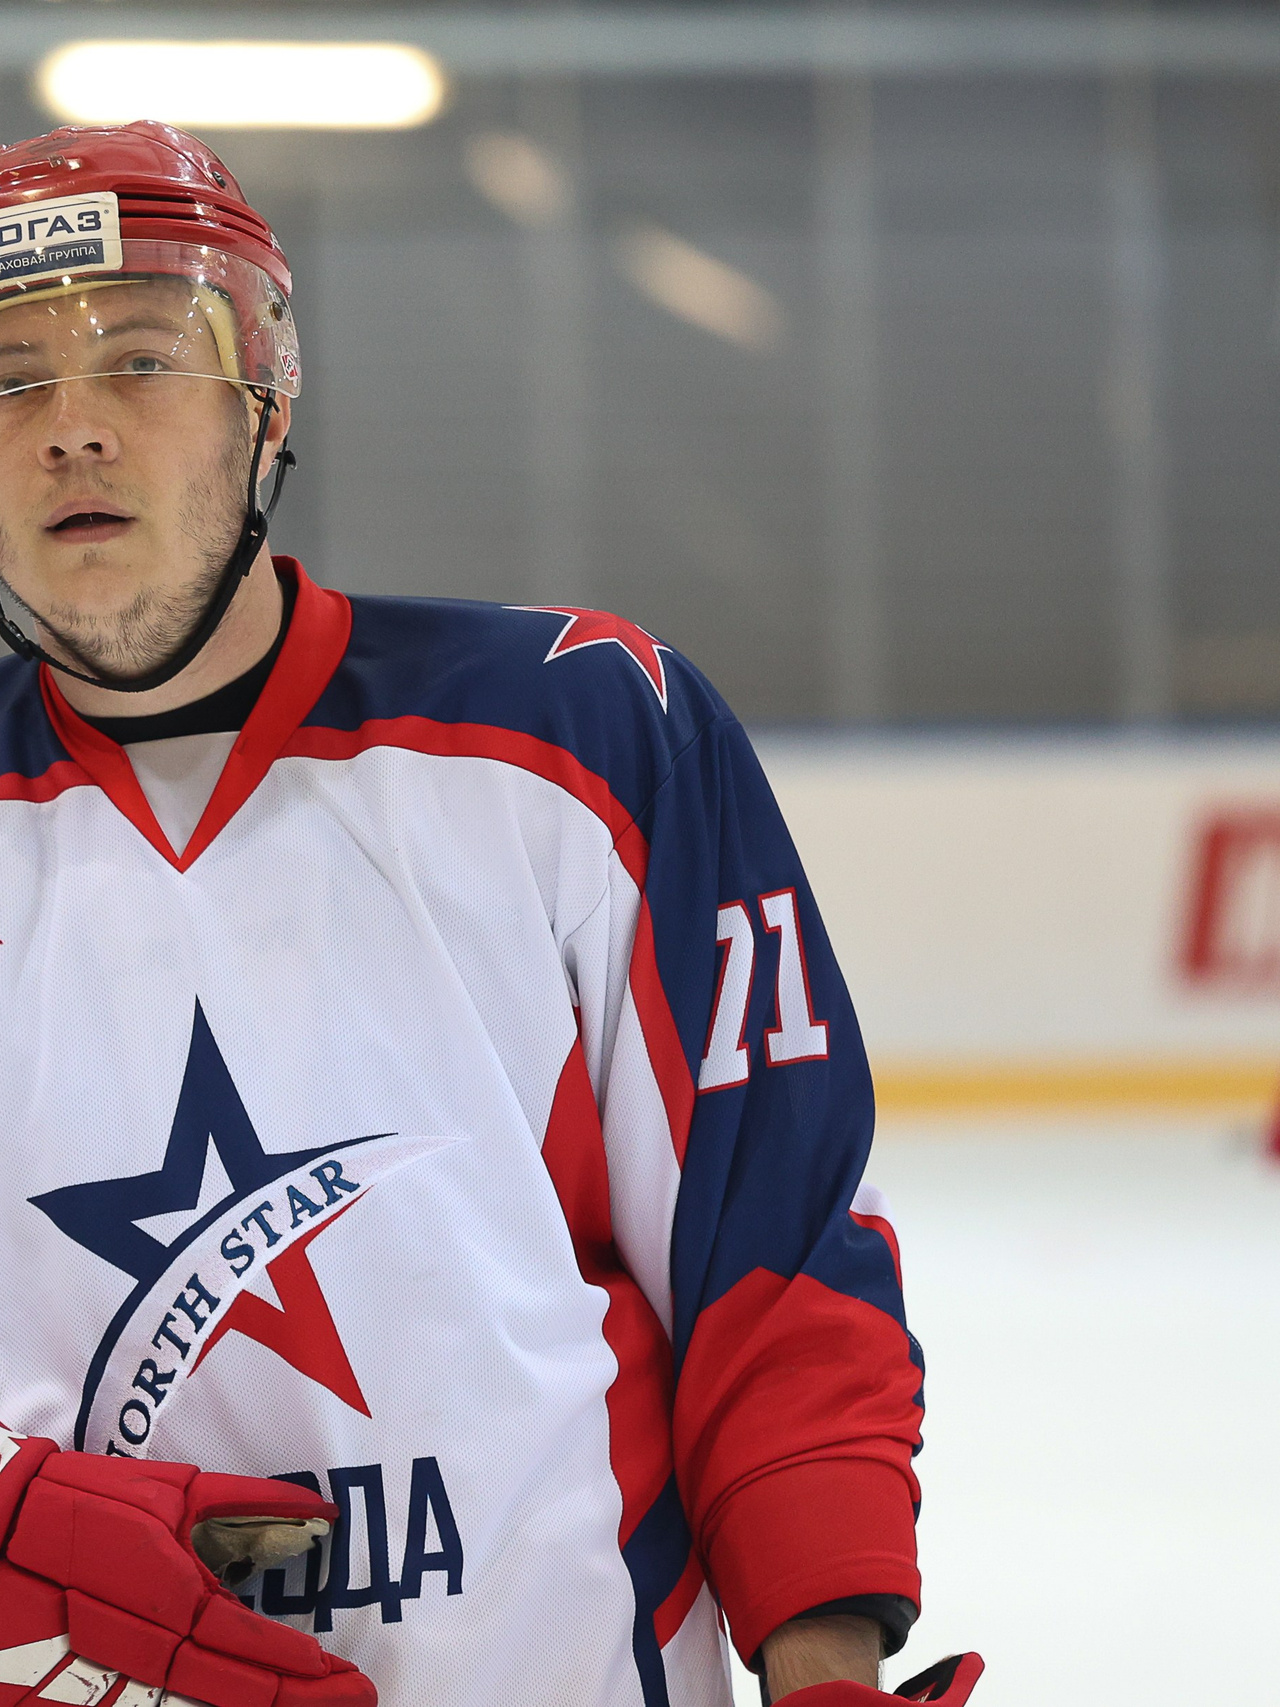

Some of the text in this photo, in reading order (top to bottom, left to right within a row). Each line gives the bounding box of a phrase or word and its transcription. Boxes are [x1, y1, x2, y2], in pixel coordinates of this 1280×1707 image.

[49, 245, 97, 262] ГРУППА
[696, 886, 829, 1096] 71
[220, 1159, 361, 1279] STAR
[237, 1456, 463, 1633] ЗДА
